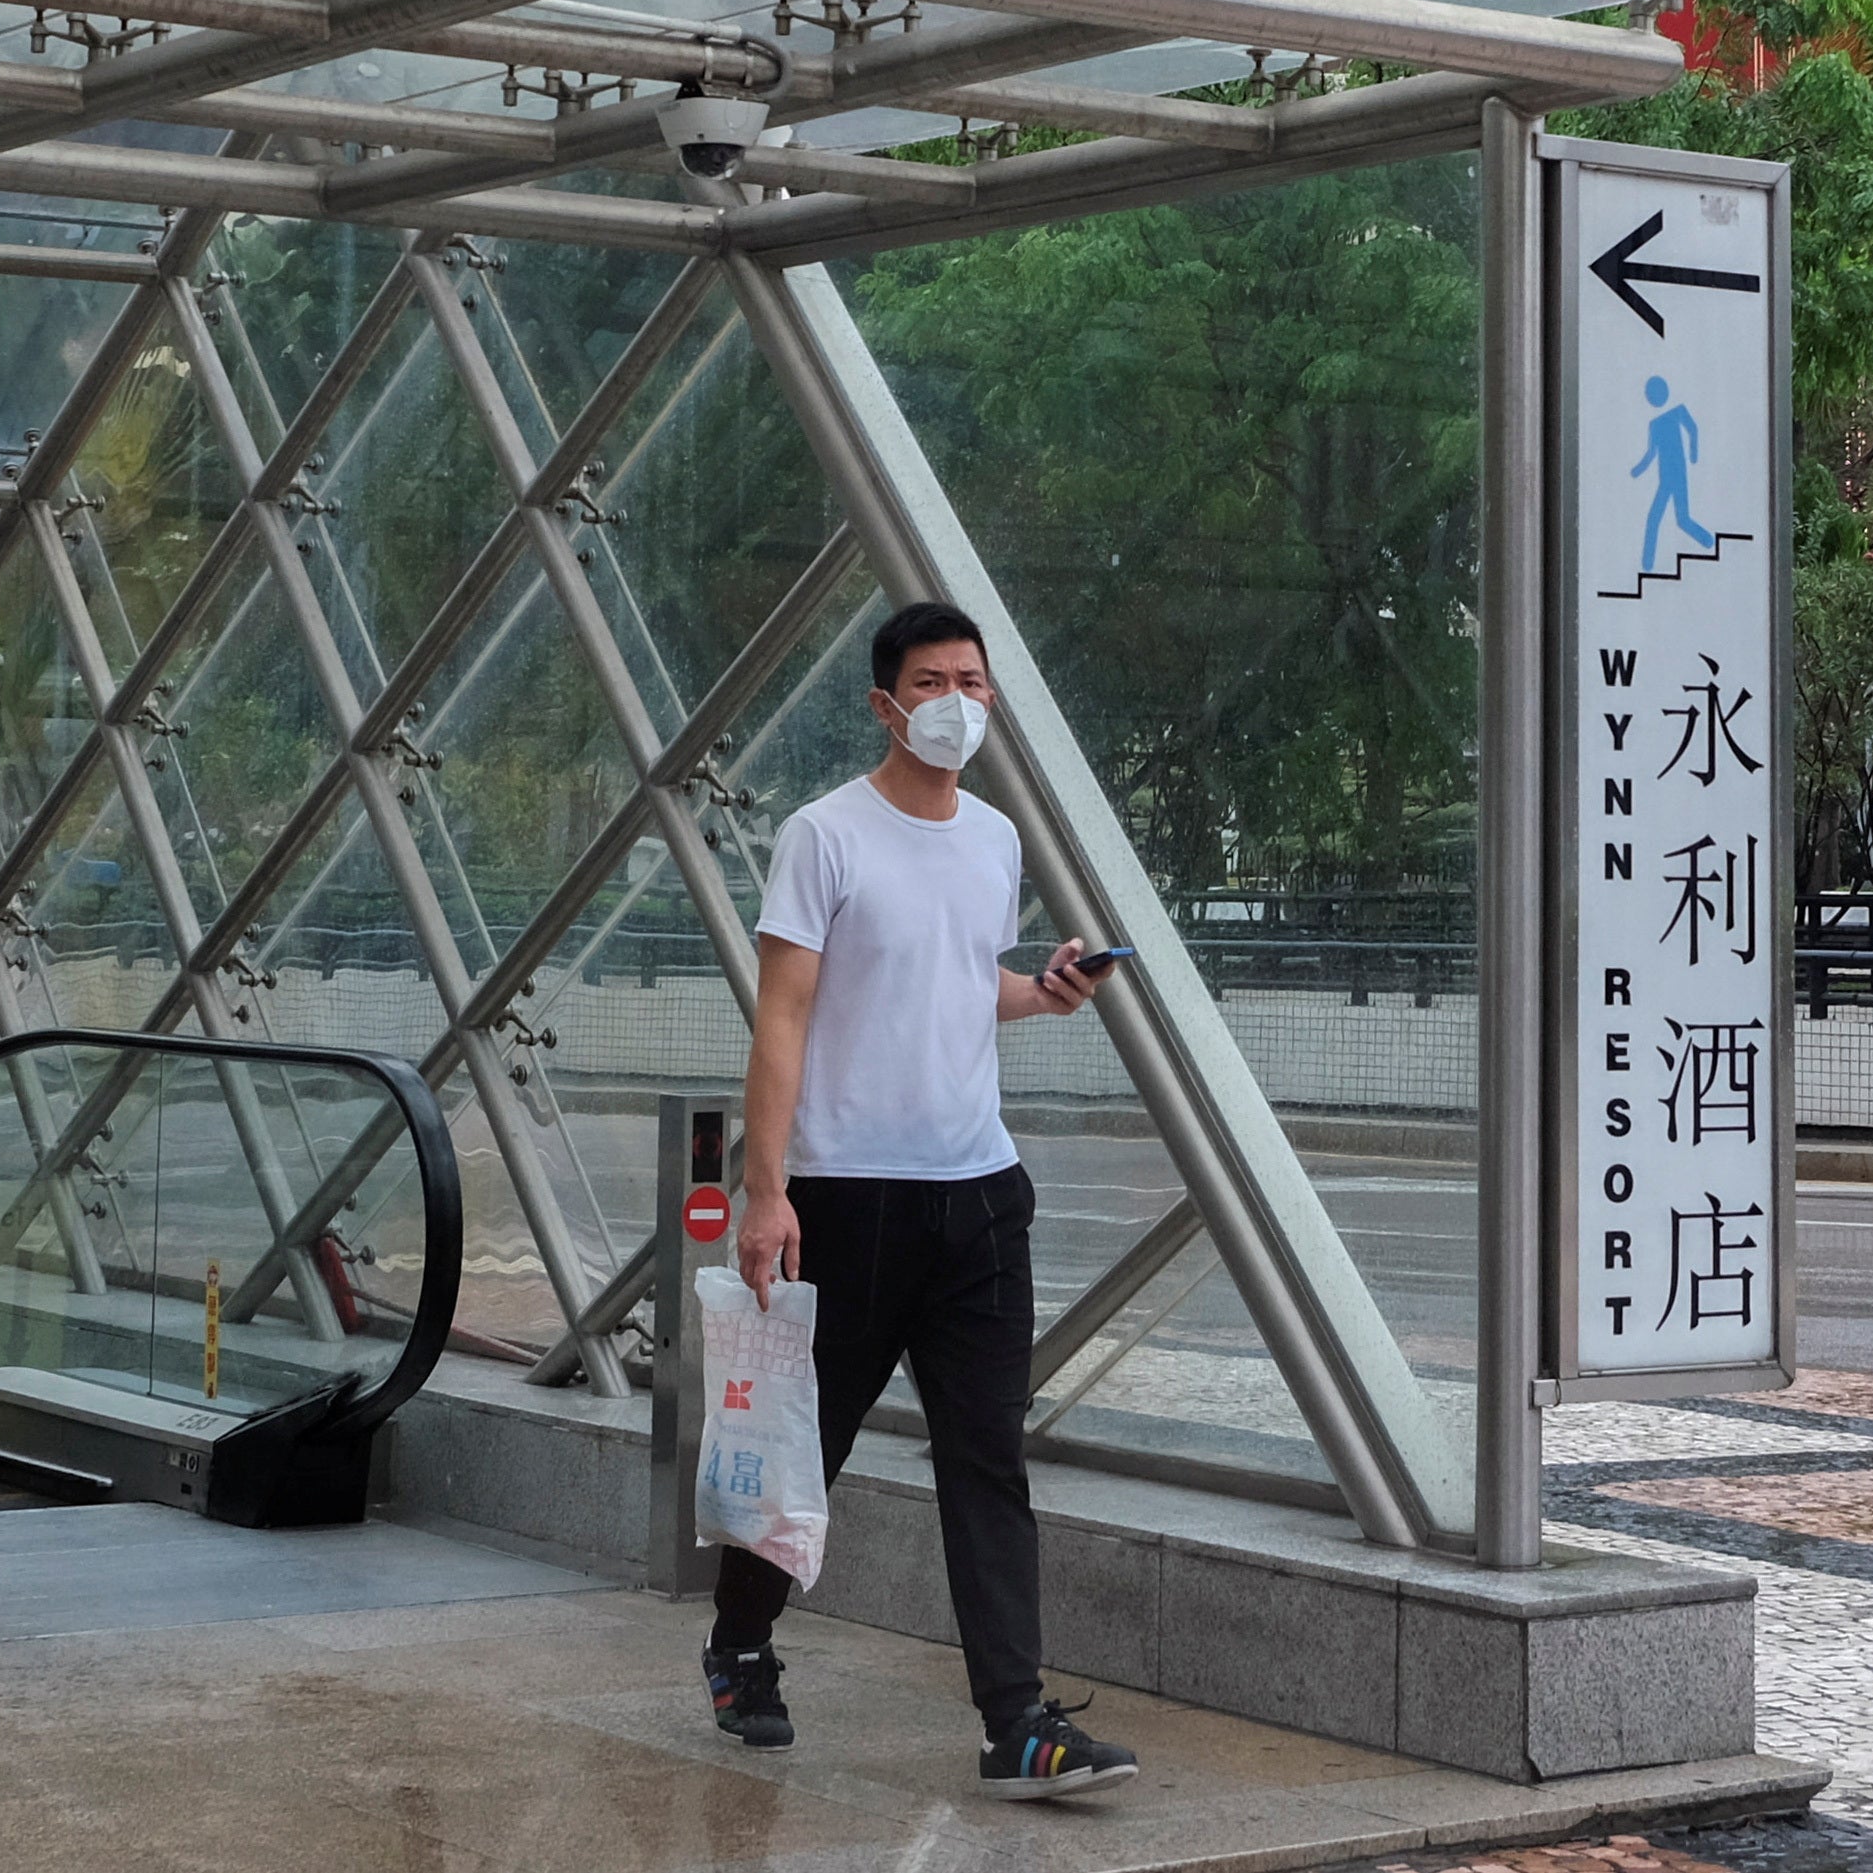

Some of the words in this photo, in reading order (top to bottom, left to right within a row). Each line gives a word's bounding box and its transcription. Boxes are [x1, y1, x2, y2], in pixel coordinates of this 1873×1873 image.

[1598, 648, 1638, 881] WYNN
[1602, 967, 1635, 1336] RESORT
[1655, 651, 1766, 1332] 永利酒店
